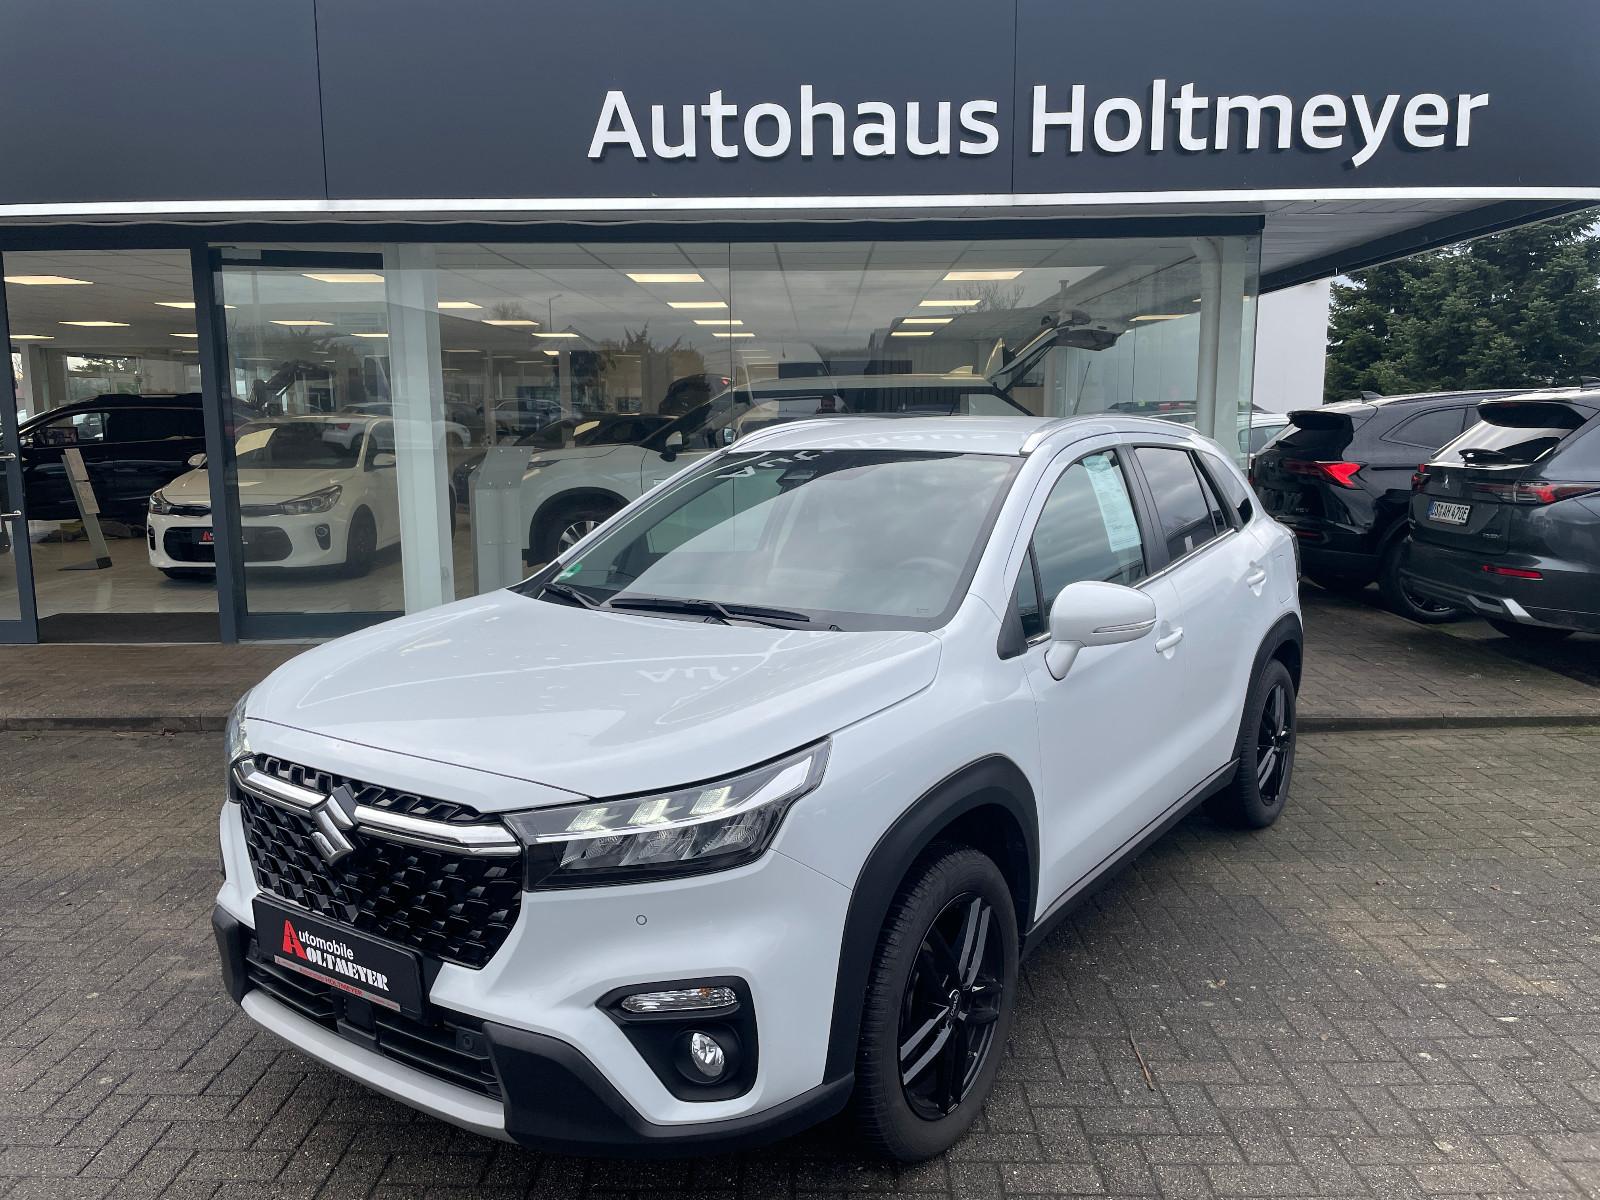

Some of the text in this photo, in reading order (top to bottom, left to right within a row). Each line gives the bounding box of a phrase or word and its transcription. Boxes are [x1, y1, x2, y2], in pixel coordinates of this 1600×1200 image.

[587, 79, 1489, 167] Autohaus Holtmeyer
[282, 919, 354, 960] Automobile
